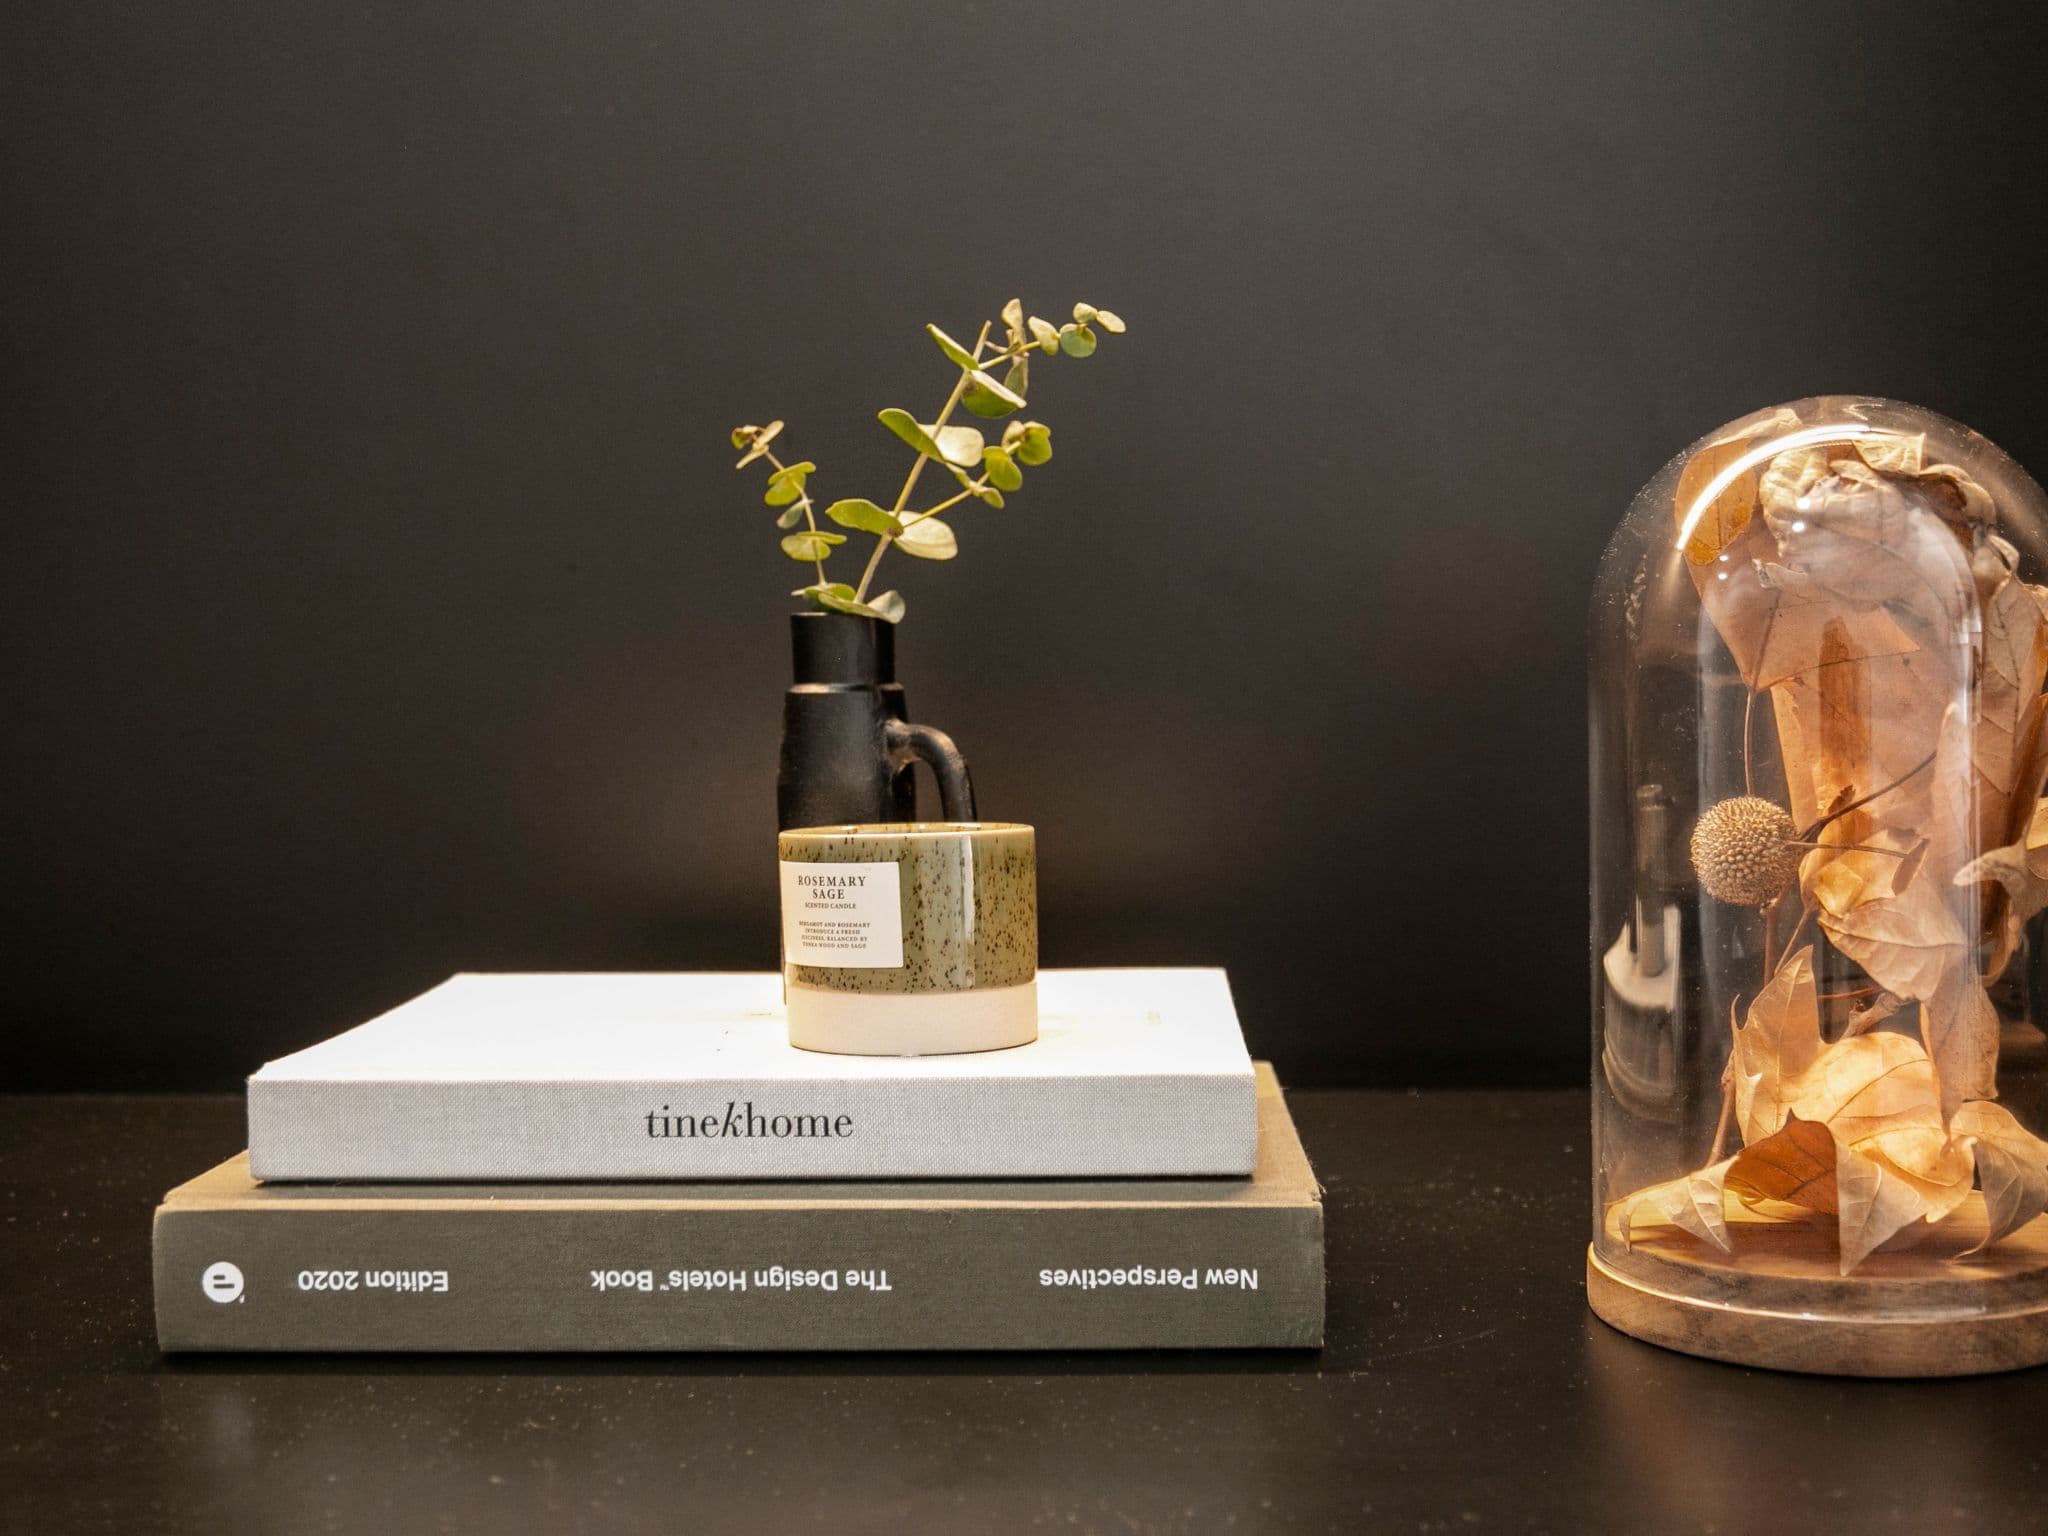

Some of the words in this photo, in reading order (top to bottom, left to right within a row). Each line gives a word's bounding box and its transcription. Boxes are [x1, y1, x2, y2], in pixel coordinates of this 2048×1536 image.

[798, 875, 866, 886] ROSEMARY
[812, 888, 845, 899] SAGE
[644, 1101, 853, 1138] tinekhome
[298, 1270, 359, 1291] 2020
[365, 1270, 449, 1291] Edition
[590, 1270, 653, 1291] Book
[754, 1265, 838, 1291] Design
[845, 1270, 892, 1291] The
[1039, 1264, 1198, 1289] Perspectives
[1205, 1268, 1258, 1289] New
